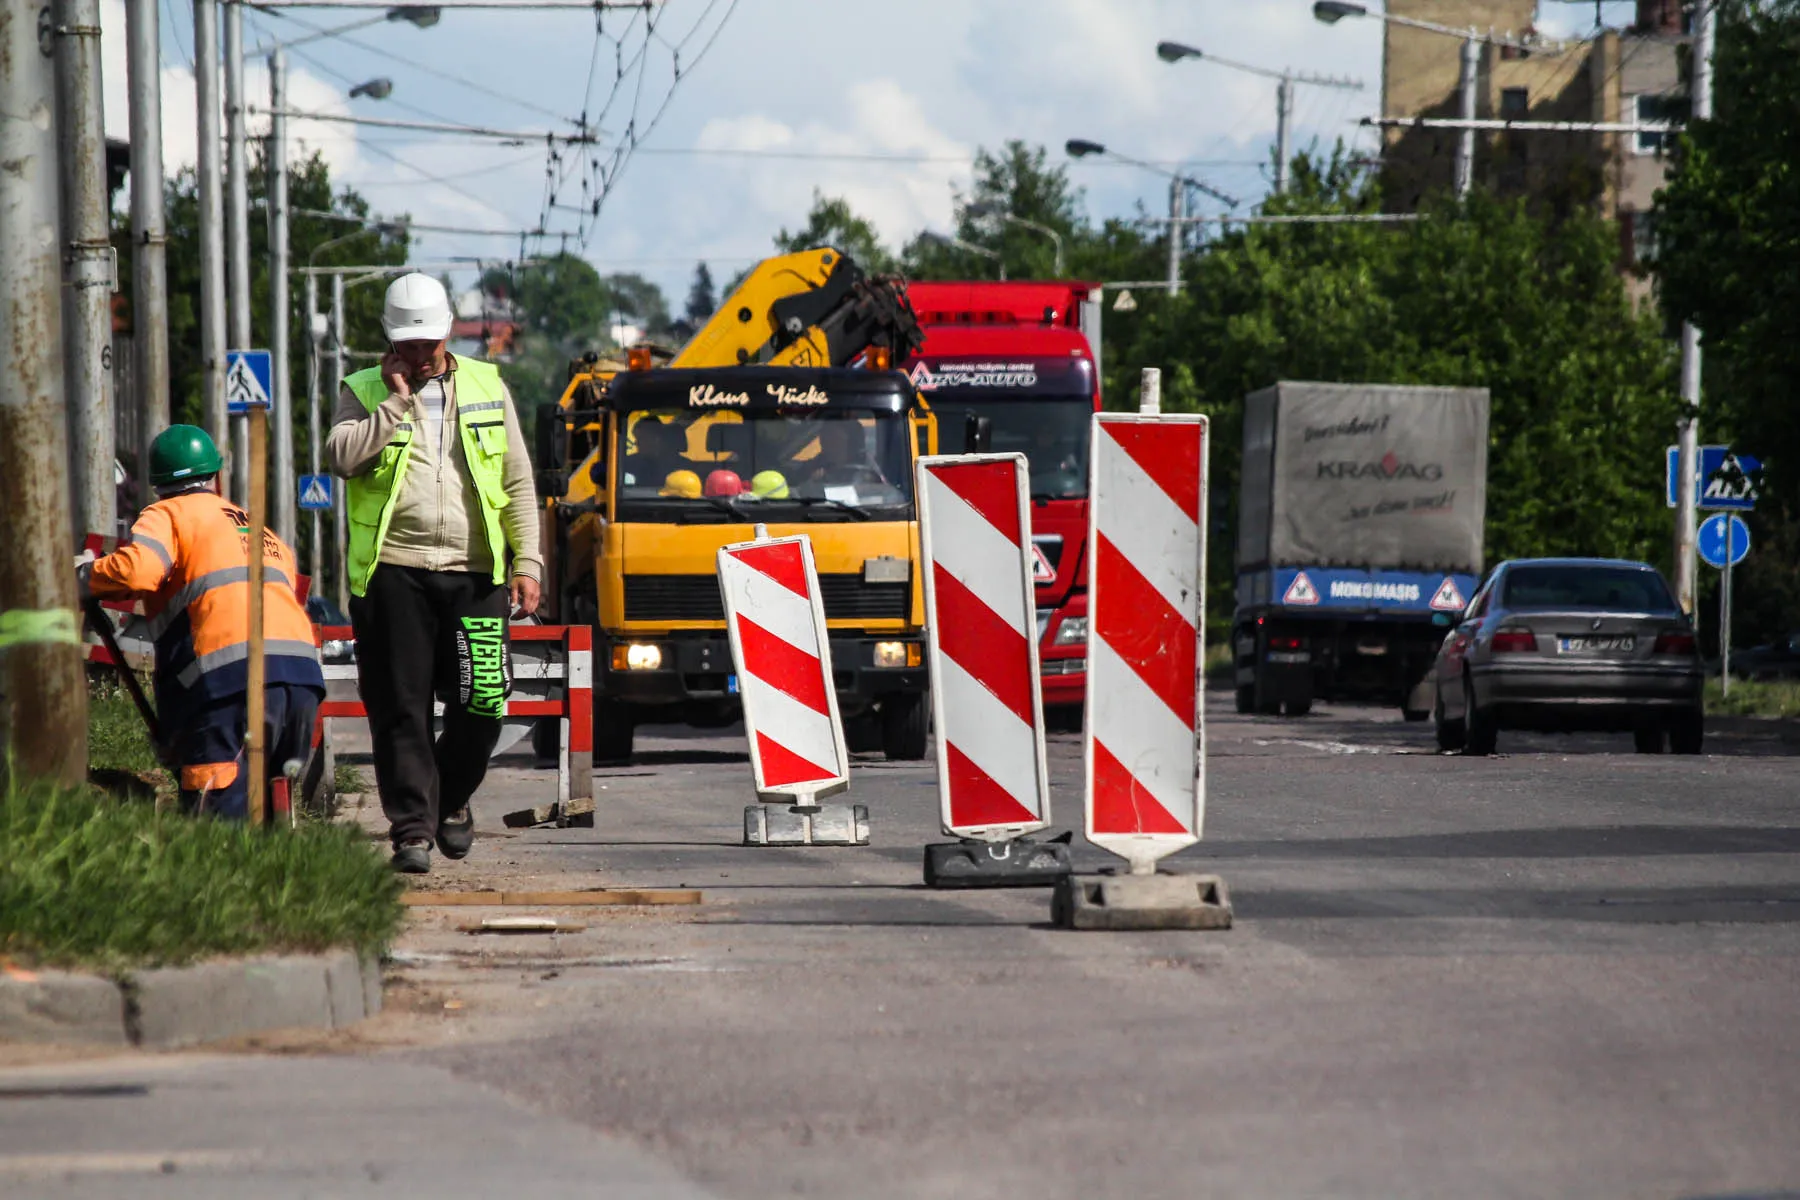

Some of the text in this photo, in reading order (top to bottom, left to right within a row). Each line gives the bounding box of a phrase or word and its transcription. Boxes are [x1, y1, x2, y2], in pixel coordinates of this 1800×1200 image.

[101, 345, 112, 370] 6
[689, 384, 750, 407] Klaus
[1316, 459, 1443, 482] KRAVAG
[456, 630, 470, 657] GLORY
[459, 658, 472, 686] NEVER
